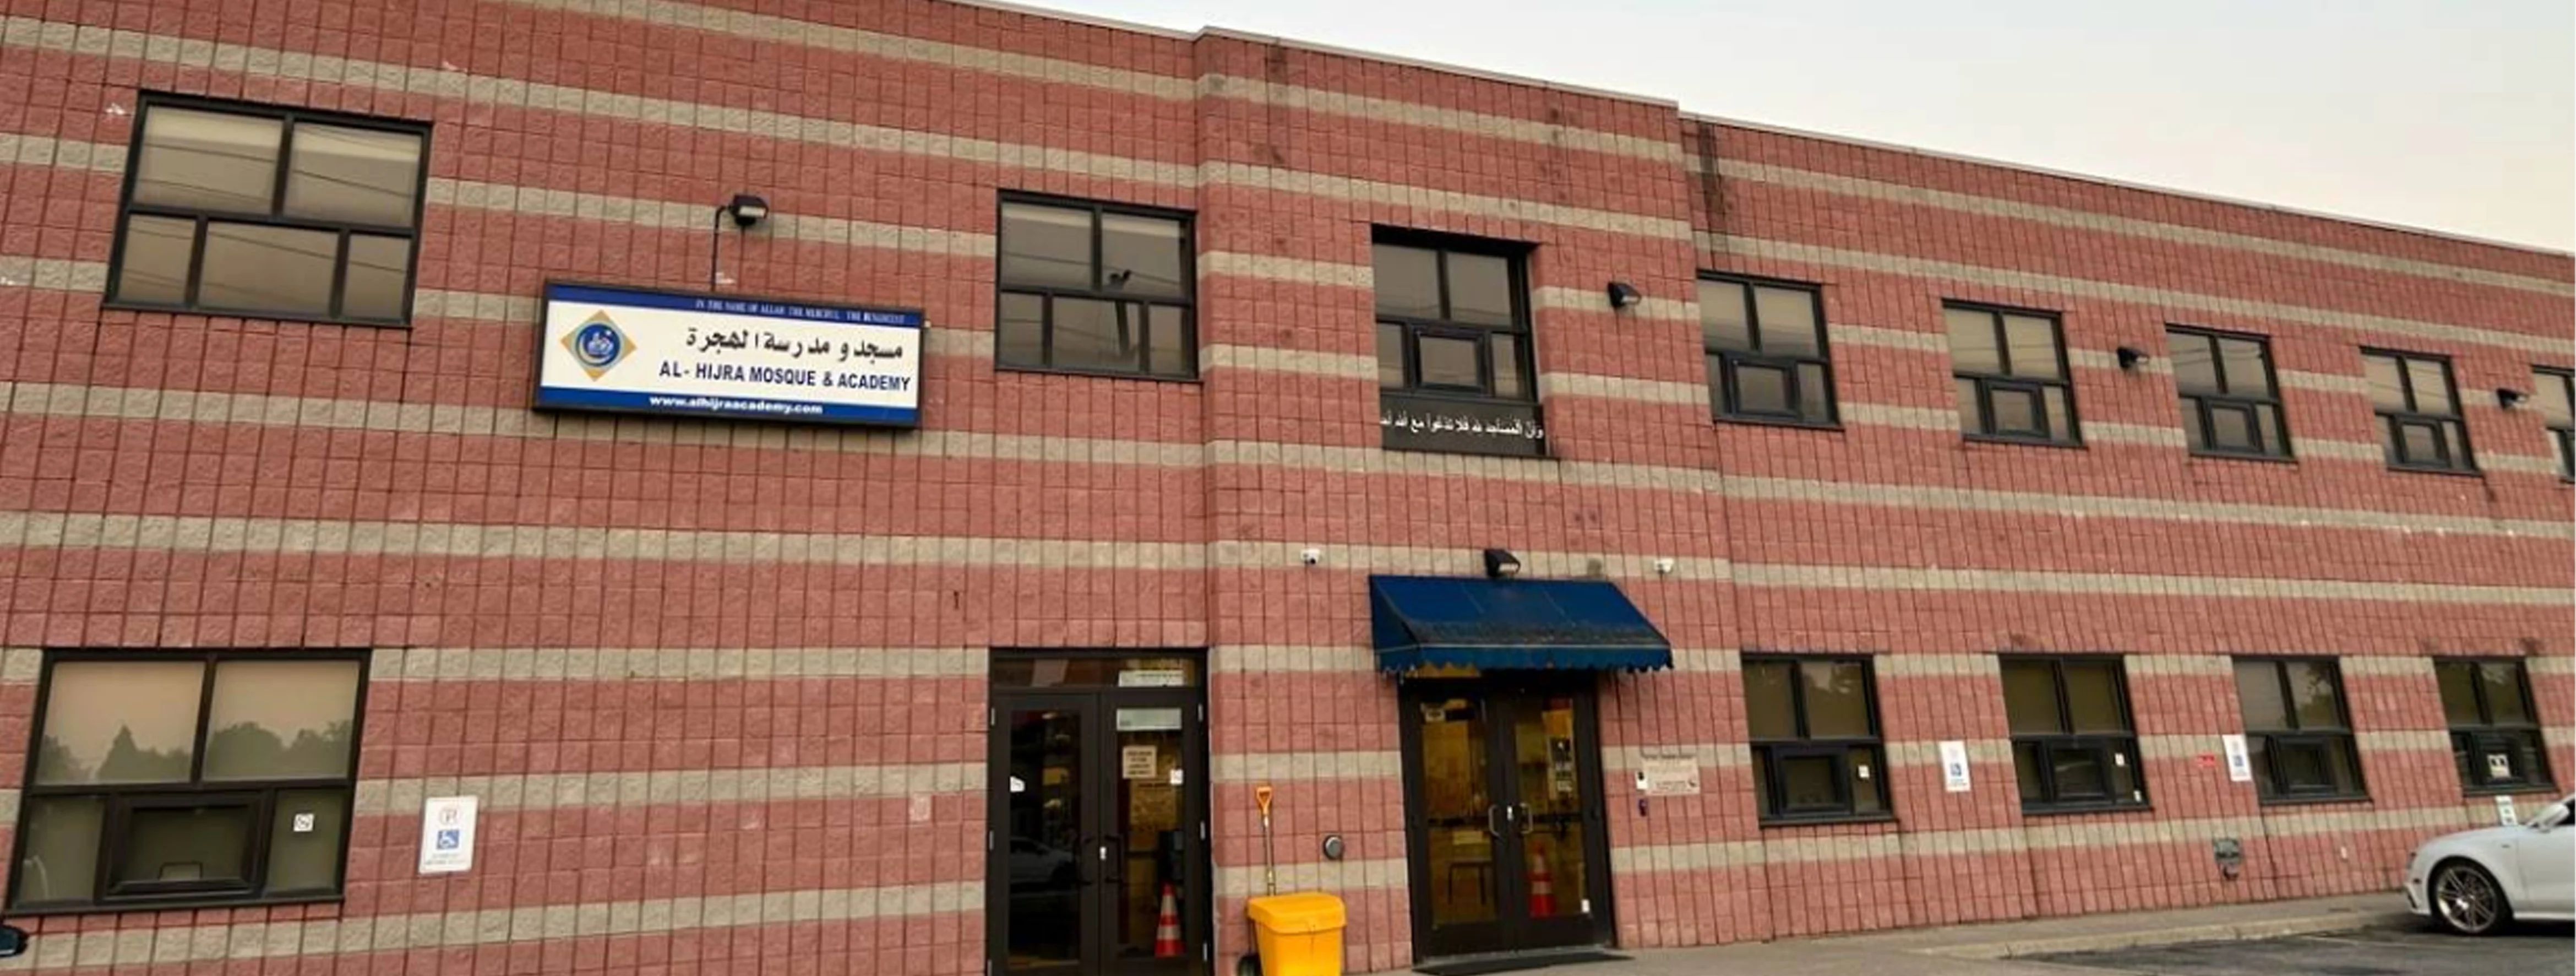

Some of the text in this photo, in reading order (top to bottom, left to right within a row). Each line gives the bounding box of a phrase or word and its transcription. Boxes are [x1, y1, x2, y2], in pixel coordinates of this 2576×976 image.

[760, 303, 785, 315] ALLAH
[837, 344, 848, 361] و
[853, 340, 903, 363] مسجد
[695, 363, 744, 382] HIJRA
[749, 366, 816, 387] MOSQUE
[822, 371, 833, 387] &
[837, 372, 911, 392] ACADEMY
[649, 394, 823, 415] www.alhijraacademy.com
